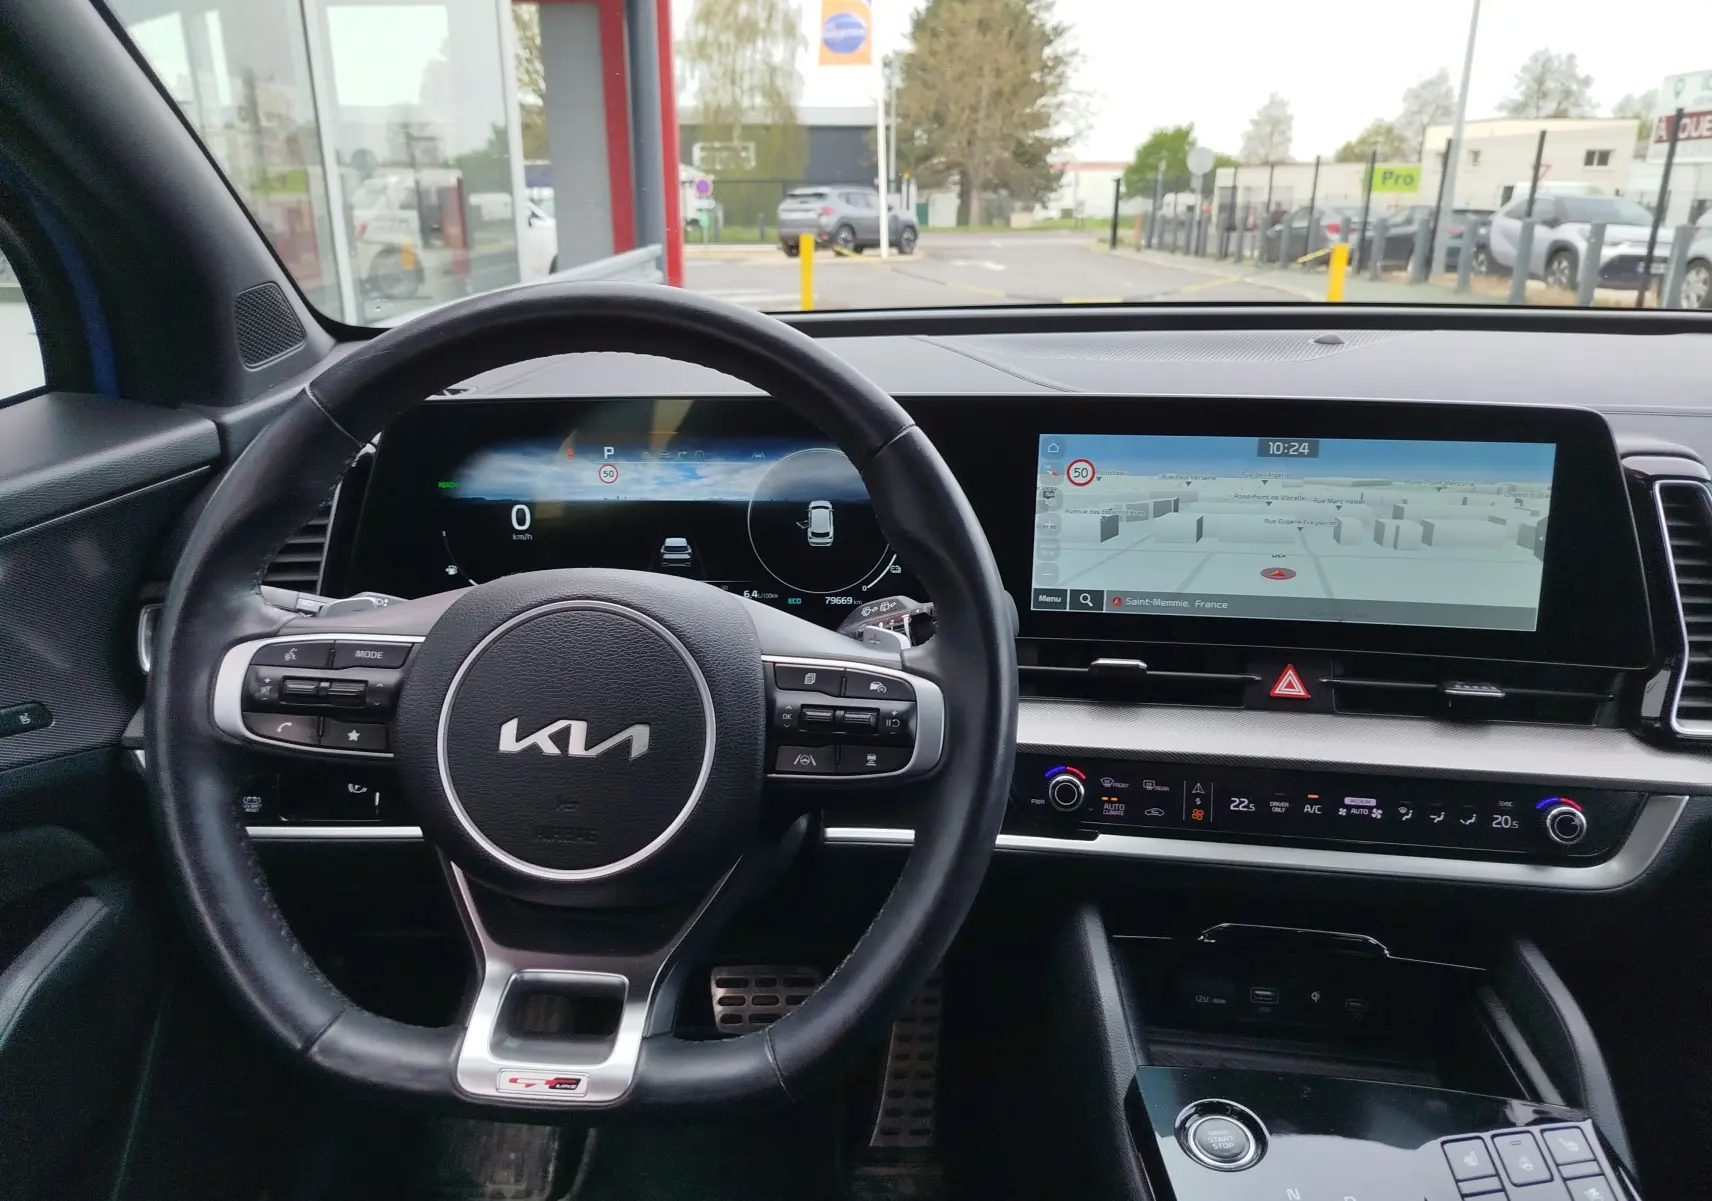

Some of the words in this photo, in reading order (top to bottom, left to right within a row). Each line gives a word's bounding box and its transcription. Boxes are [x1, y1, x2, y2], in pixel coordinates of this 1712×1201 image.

[1382, 171, 1414, 186] Pro
[604, 447, 614, 459] P
[1268, 442, 1309, 455] 10:24
[1073, 467, 1089, 479] 50
[511, 504, 531, 530] 0
[512, 533, 533, 541] km/h
[824, 597, 853, 605] 79669
[1039, 595, 1061, 603] Menu
[1195, 600, 1228, 609] France
[355, 650, 384, 659] MODE
[499, 717, 651, 762] KIA
[1303, 804, 1322, 814] A/C
[1212, 1142, 1235, 1150] STOP
[1286, 1188, 1301, 1200] N
